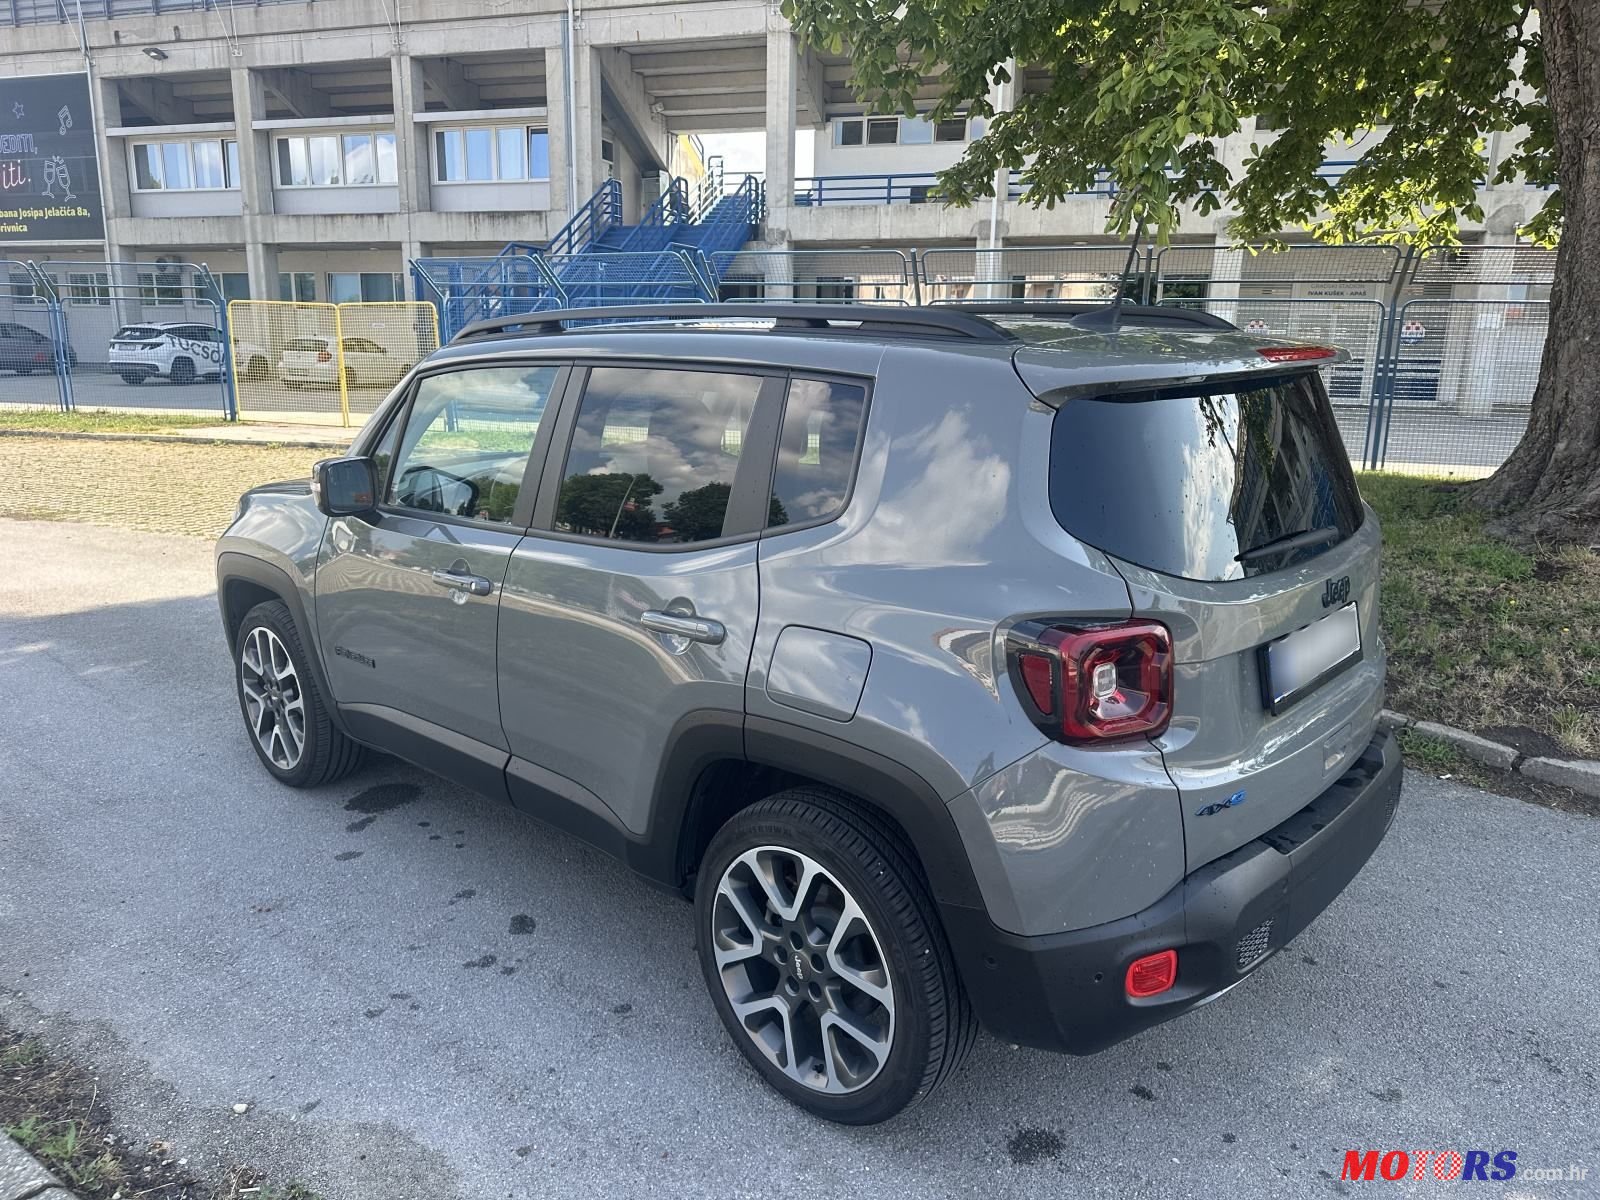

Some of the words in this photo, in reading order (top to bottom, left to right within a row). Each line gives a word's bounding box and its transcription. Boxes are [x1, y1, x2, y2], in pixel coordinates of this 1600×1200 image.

[19, 207, 43, 220] Josipa
[44, 206, 76, 219] Jelačića
[77, 206, 91, 218] 8a,
[166, 334, 225, 365] TUCSO
[1321, 576, 1350, 608] Jeep
[794, 955, 804, 980] Jeep
